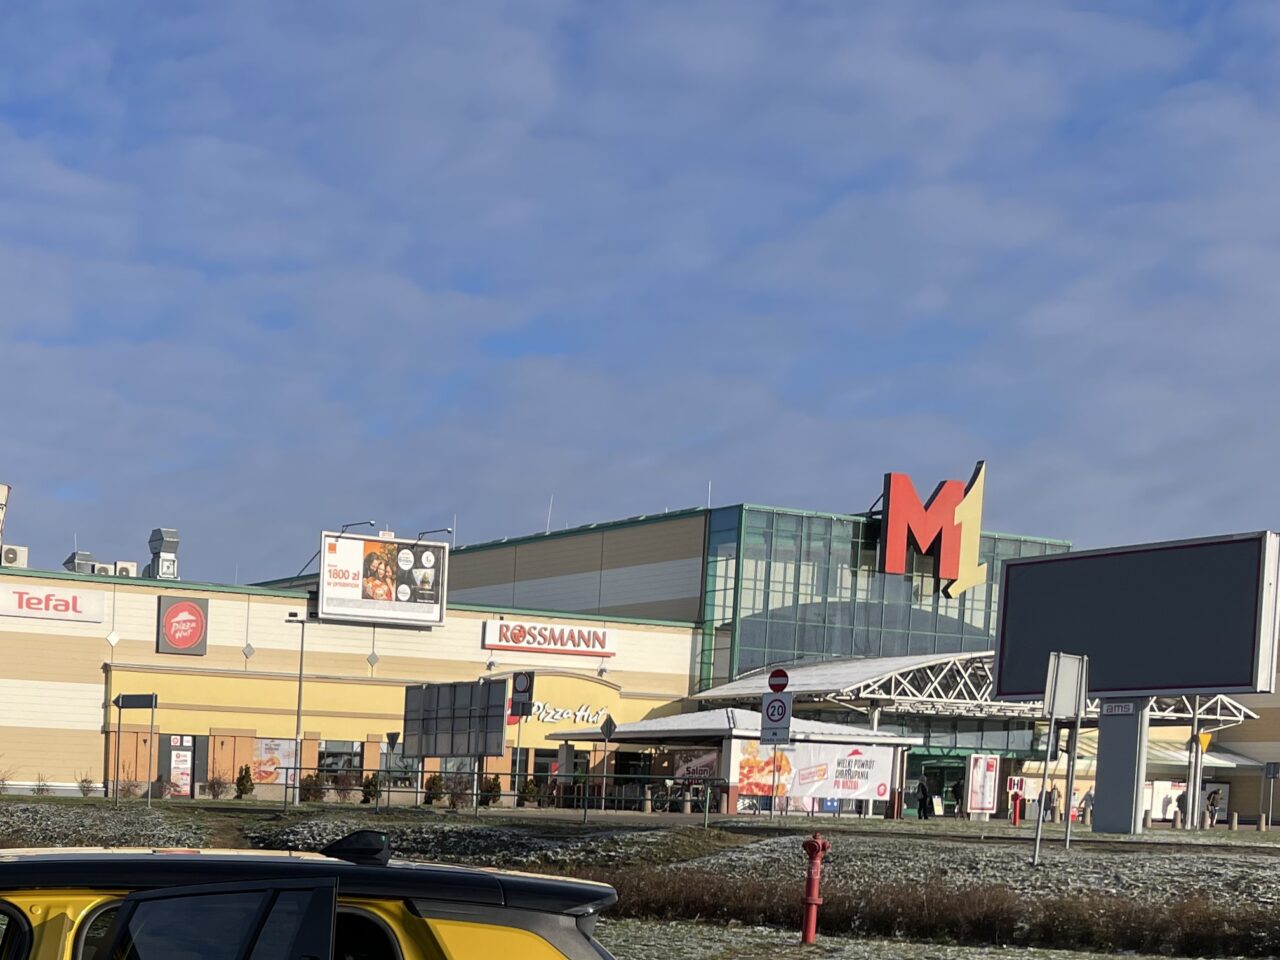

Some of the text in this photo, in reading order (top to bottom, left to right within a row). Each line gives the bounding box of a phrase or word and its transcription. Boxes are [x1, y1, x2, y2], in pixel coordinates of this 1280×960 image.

[884, 460, 987, 599] M1
[328, 568, 350, 580] 1800
[12, 591, 82, 613] Tefal
[170, 621, 197, 635] Pizza
[175, 629, 193, 639] Hut
[499, 624, 607, 649] ROSSMANN
[525, 700, 610, 724] Pizza Hut
[770, 705, 784, 716] 20
[1106, 704, 1130, 713] ams
